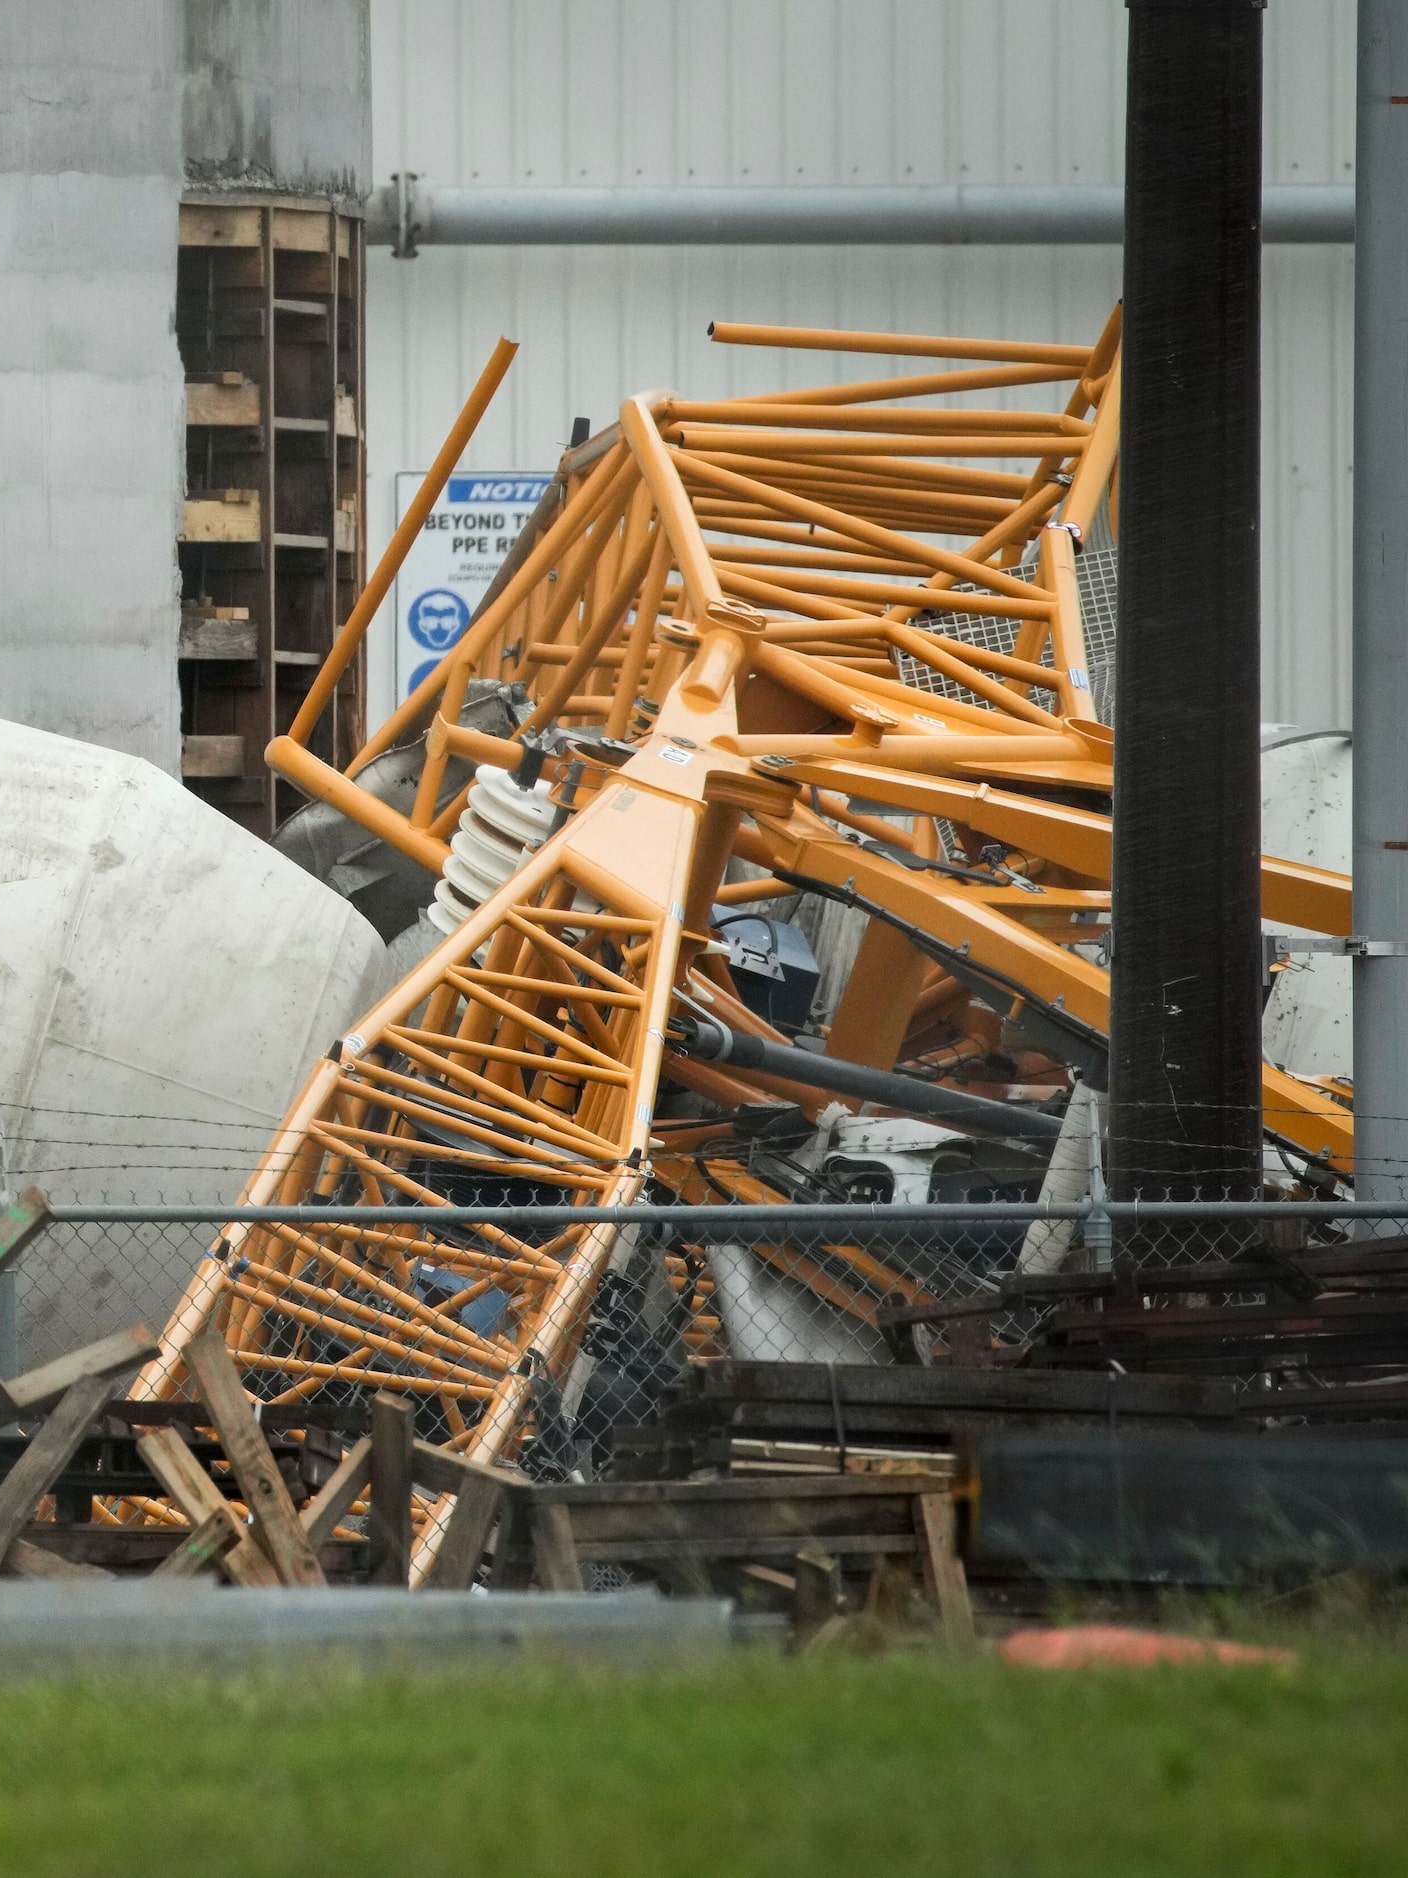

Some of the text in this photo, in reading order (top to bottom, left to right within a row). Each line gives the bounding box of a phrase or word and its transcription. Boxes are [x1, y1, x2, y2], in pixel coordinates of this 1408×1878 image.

[425, 514, 530, 530] BEYOND T
[452, 537, 488, 553] PPE
